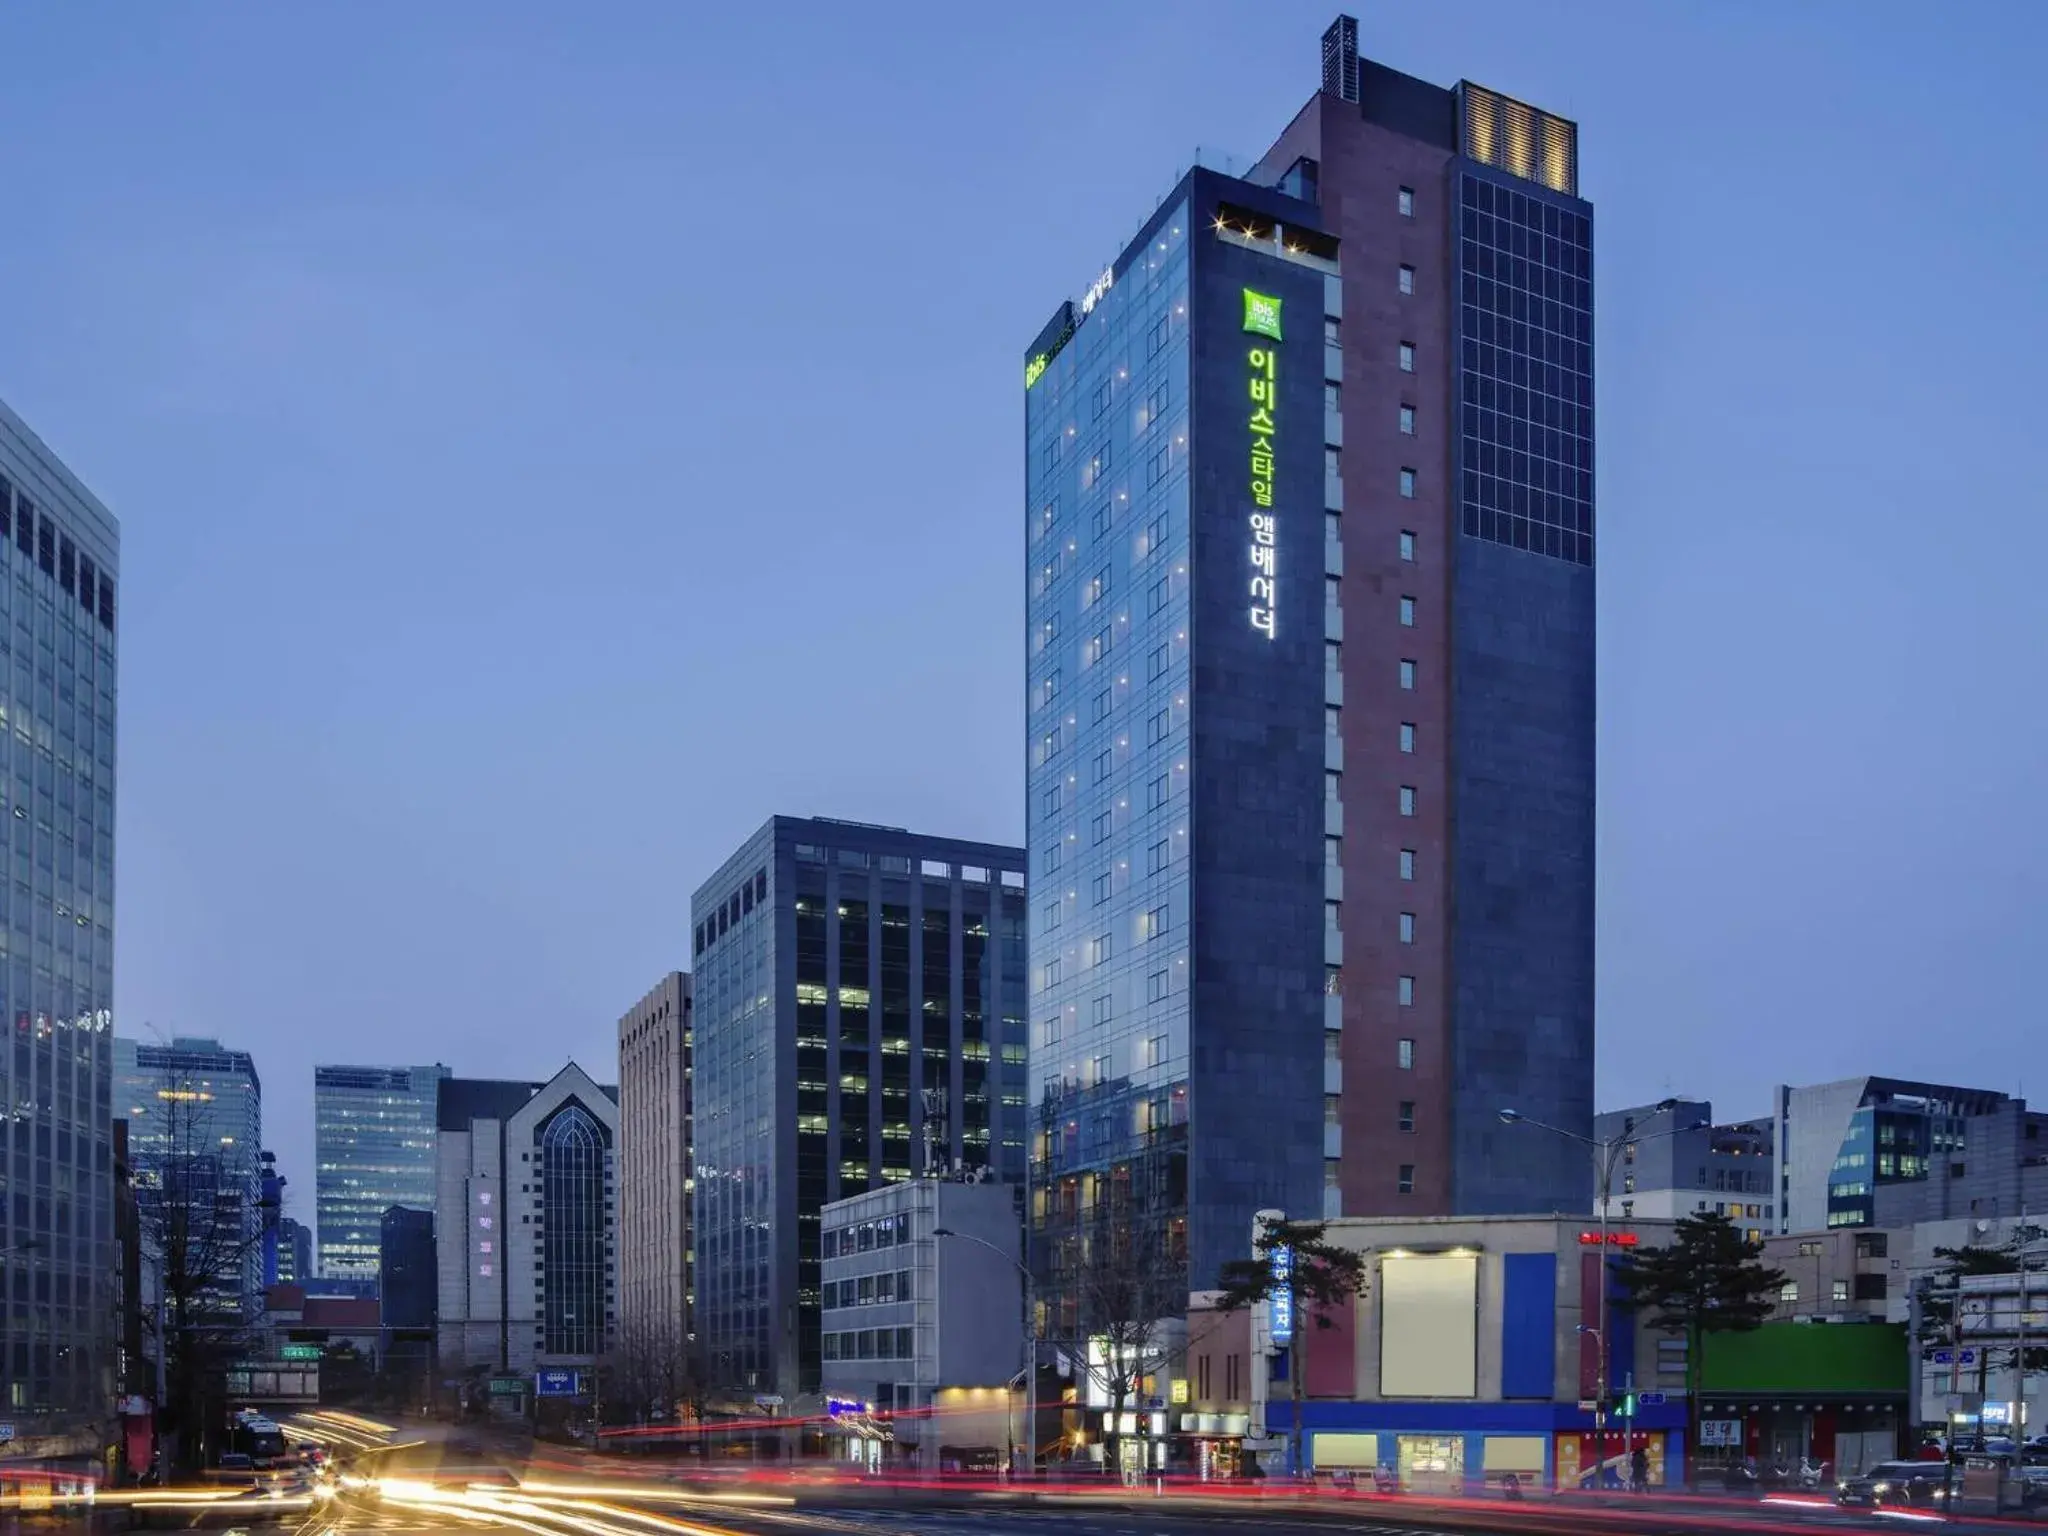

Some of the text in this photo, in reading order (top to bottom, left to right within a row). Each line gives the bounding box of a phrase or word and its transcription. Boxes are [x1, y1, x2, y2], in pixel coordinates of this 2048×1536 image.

[1253, 300, 1274, 317] ibis
[1026, 353, 1046, 389] ibis
[1249, 513, 1274, 640] 앰배서더
